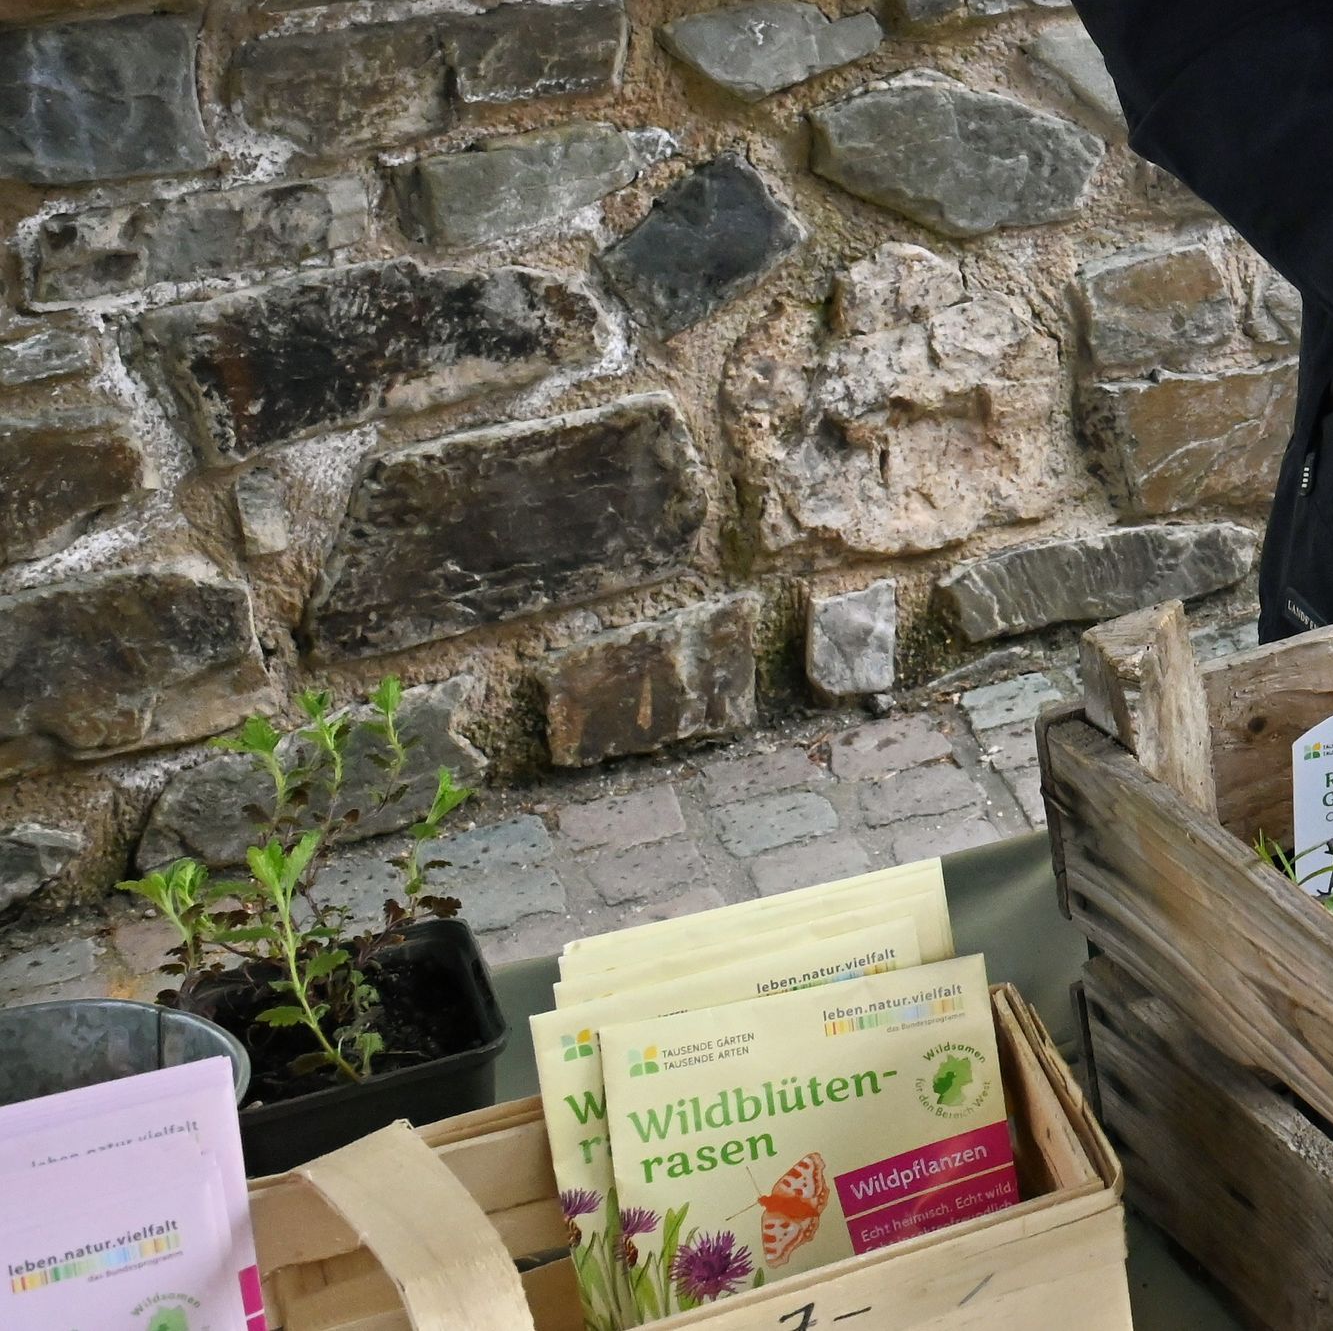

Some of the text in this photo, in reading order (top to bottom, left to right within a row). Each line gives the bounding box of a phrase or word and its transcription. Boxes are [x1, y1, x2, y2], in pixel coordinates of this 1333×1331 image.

[757, 948, 896, 994] leben.natur.vielfalt
[823, 984, 962, 1021] leben.natur.vielfalt
[662, 1032, 755, 1058] TAUSENDE GÄRTEN
[663, 1046, 750, 1071] TAUSENDE ARTEN
[923, 1042, 986, 1063] Wildsamen
[627, 1067, 899, 1143] Wildblüten-
[641, 1132, 778, 1184] rasen
[851, 1145, 987, 1200] Wildpflanzen
[861, 1224, 891, 1243] Echt
[894, 1202, 953, 1232] heimisch.
[955, 1193, 983, 1210] Echt
[8, 1220, 178, 1277] leben.natur.vielfalt
[131, 1292, 201, 1318] Wildsamen
